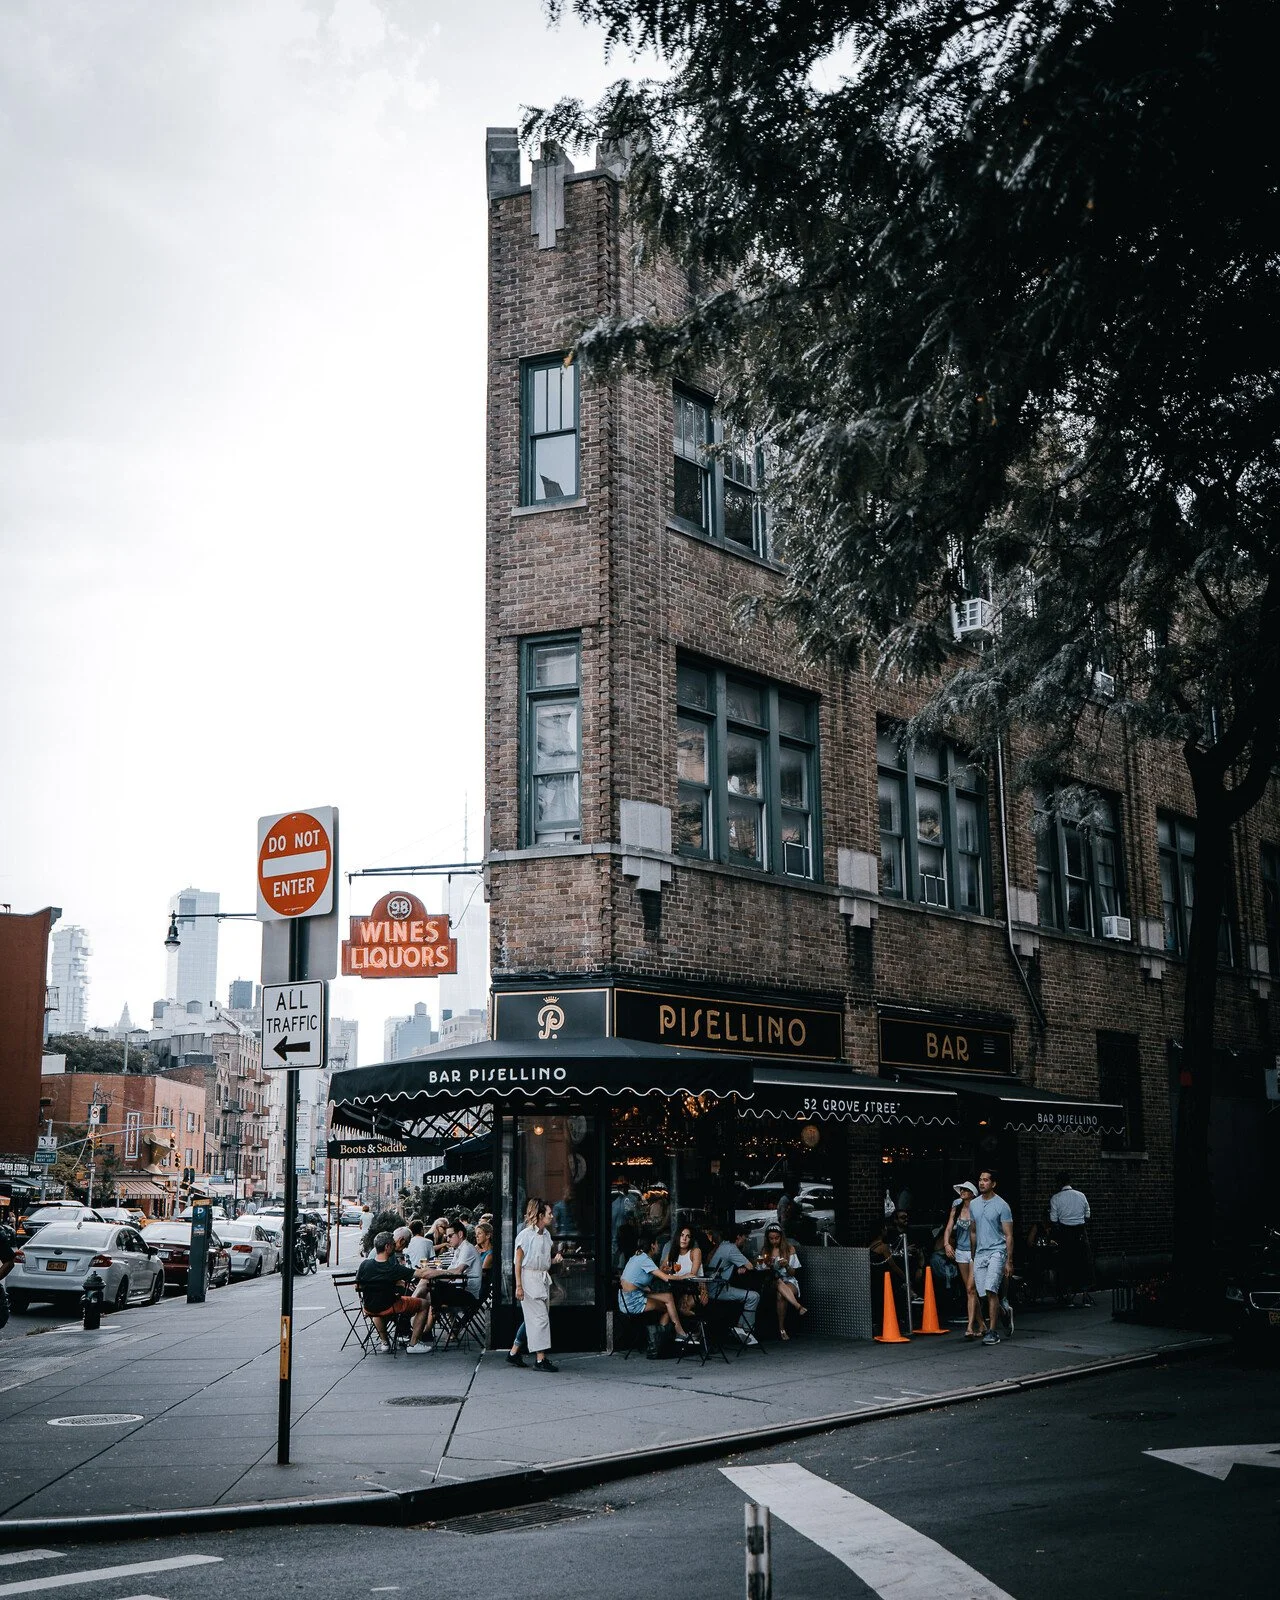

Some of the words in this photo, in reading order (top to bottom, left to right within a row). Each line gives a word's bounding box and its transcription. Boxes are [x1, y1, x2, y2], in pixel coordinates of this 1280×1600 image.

[268, 835, 287, 853] DO
[294, 829, 321, 849] NOT
[273, 877, 315, 898] ENTER
[360, 920, 440, 943] WINES
[351, 945, 449, 970] LIQUORS
[275, 990, 309, 1011] ALL
[266, 1014, 318, 1034] TRAFFIC
[659, 1004, 806, 1047] PISELLINO
[926, 1032, 970, 1062] BAR
[429, 1070, 461, 1083] BAR
[469, 1067, 567, 1082] PISELLINO
[803, 1098, 817, 1111] 52
[822, 1099, 860, 1113] GROVE
[1037, 1113, 1054, 1124] BAR
[1057, 1115, 1098, 1126] PISELLINO
[340, 1144, 366, 1154] Boots
[367, 1144, 376, 1154] &
[377, 1143, 407, 1153] Saddle
[426, 1174, 469, 1184] SUPREMA
